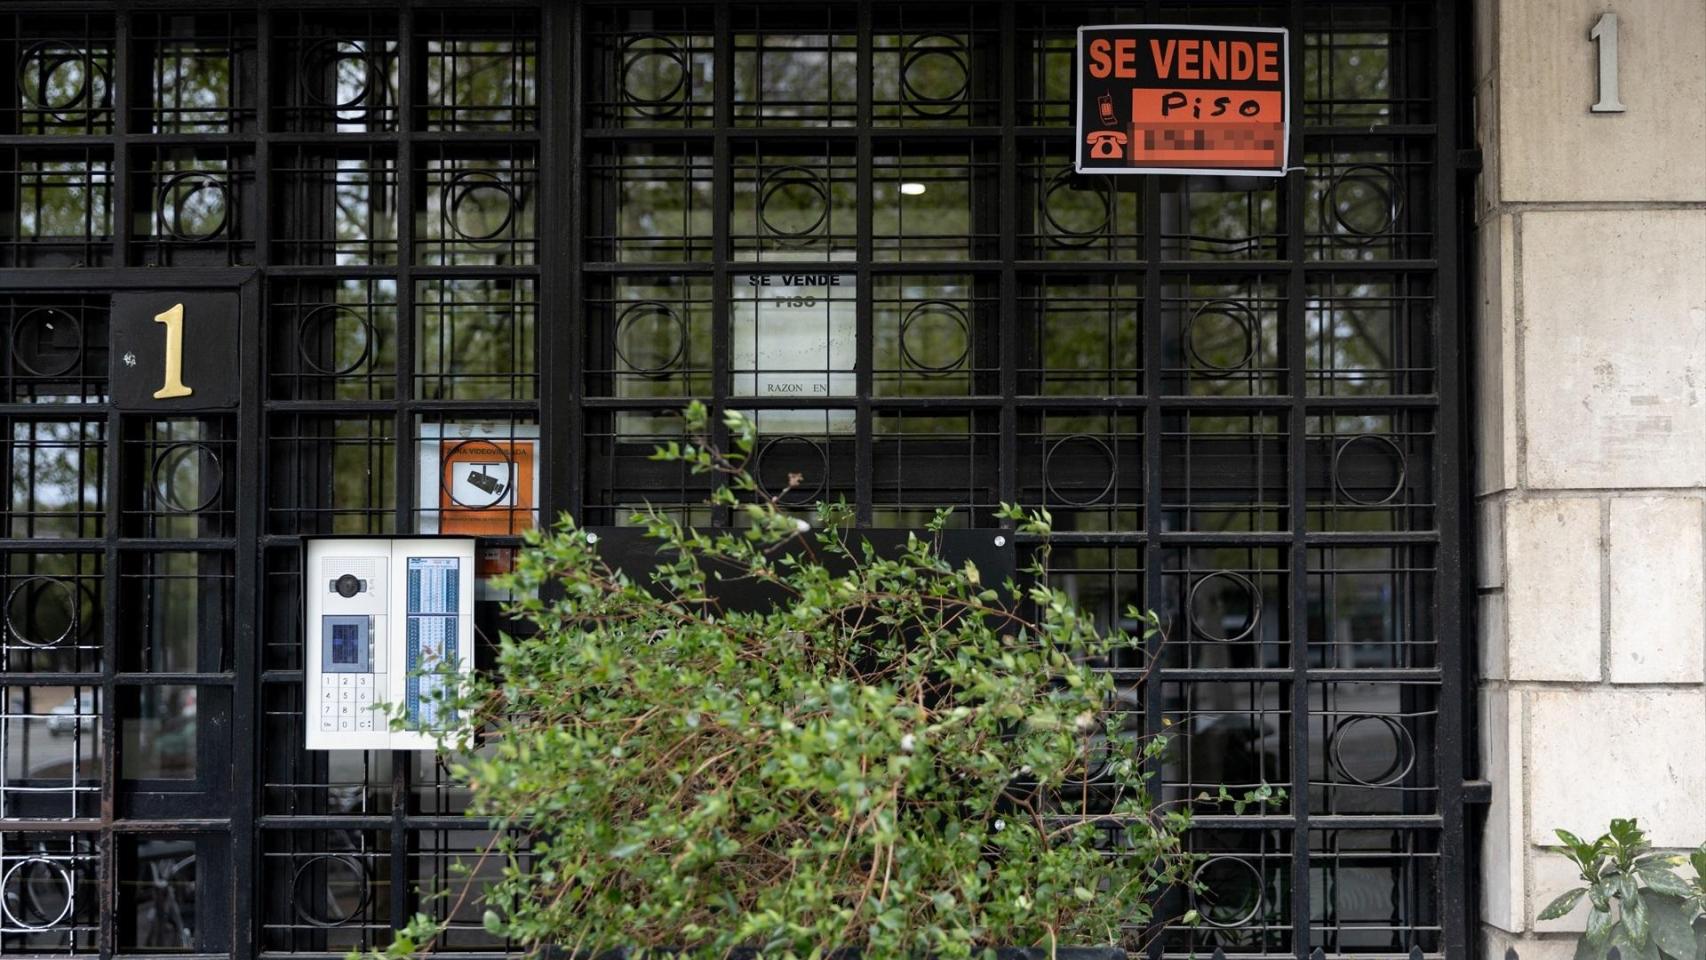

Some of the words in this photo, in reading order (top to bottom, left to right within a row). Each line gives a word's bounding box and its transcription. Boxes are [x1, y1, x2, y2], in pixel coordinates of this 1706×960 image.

[1088, 38, 1137, 79] SE
[1150, 39, 1279, 81] VENDE
[1588, 12, 1627, 113] 1
[749, 274, 771, 287] SE
[782, 274, 840, 287] VENDE
[775, 296, 816, 308] PISO
[153, 303, 193, 399] 1
[767, 383, 803, 393] RAZON
[813, 383, 827, 393] EN
[343, 692, 348, 700] 5
[342, 706, 348, 714] 8
